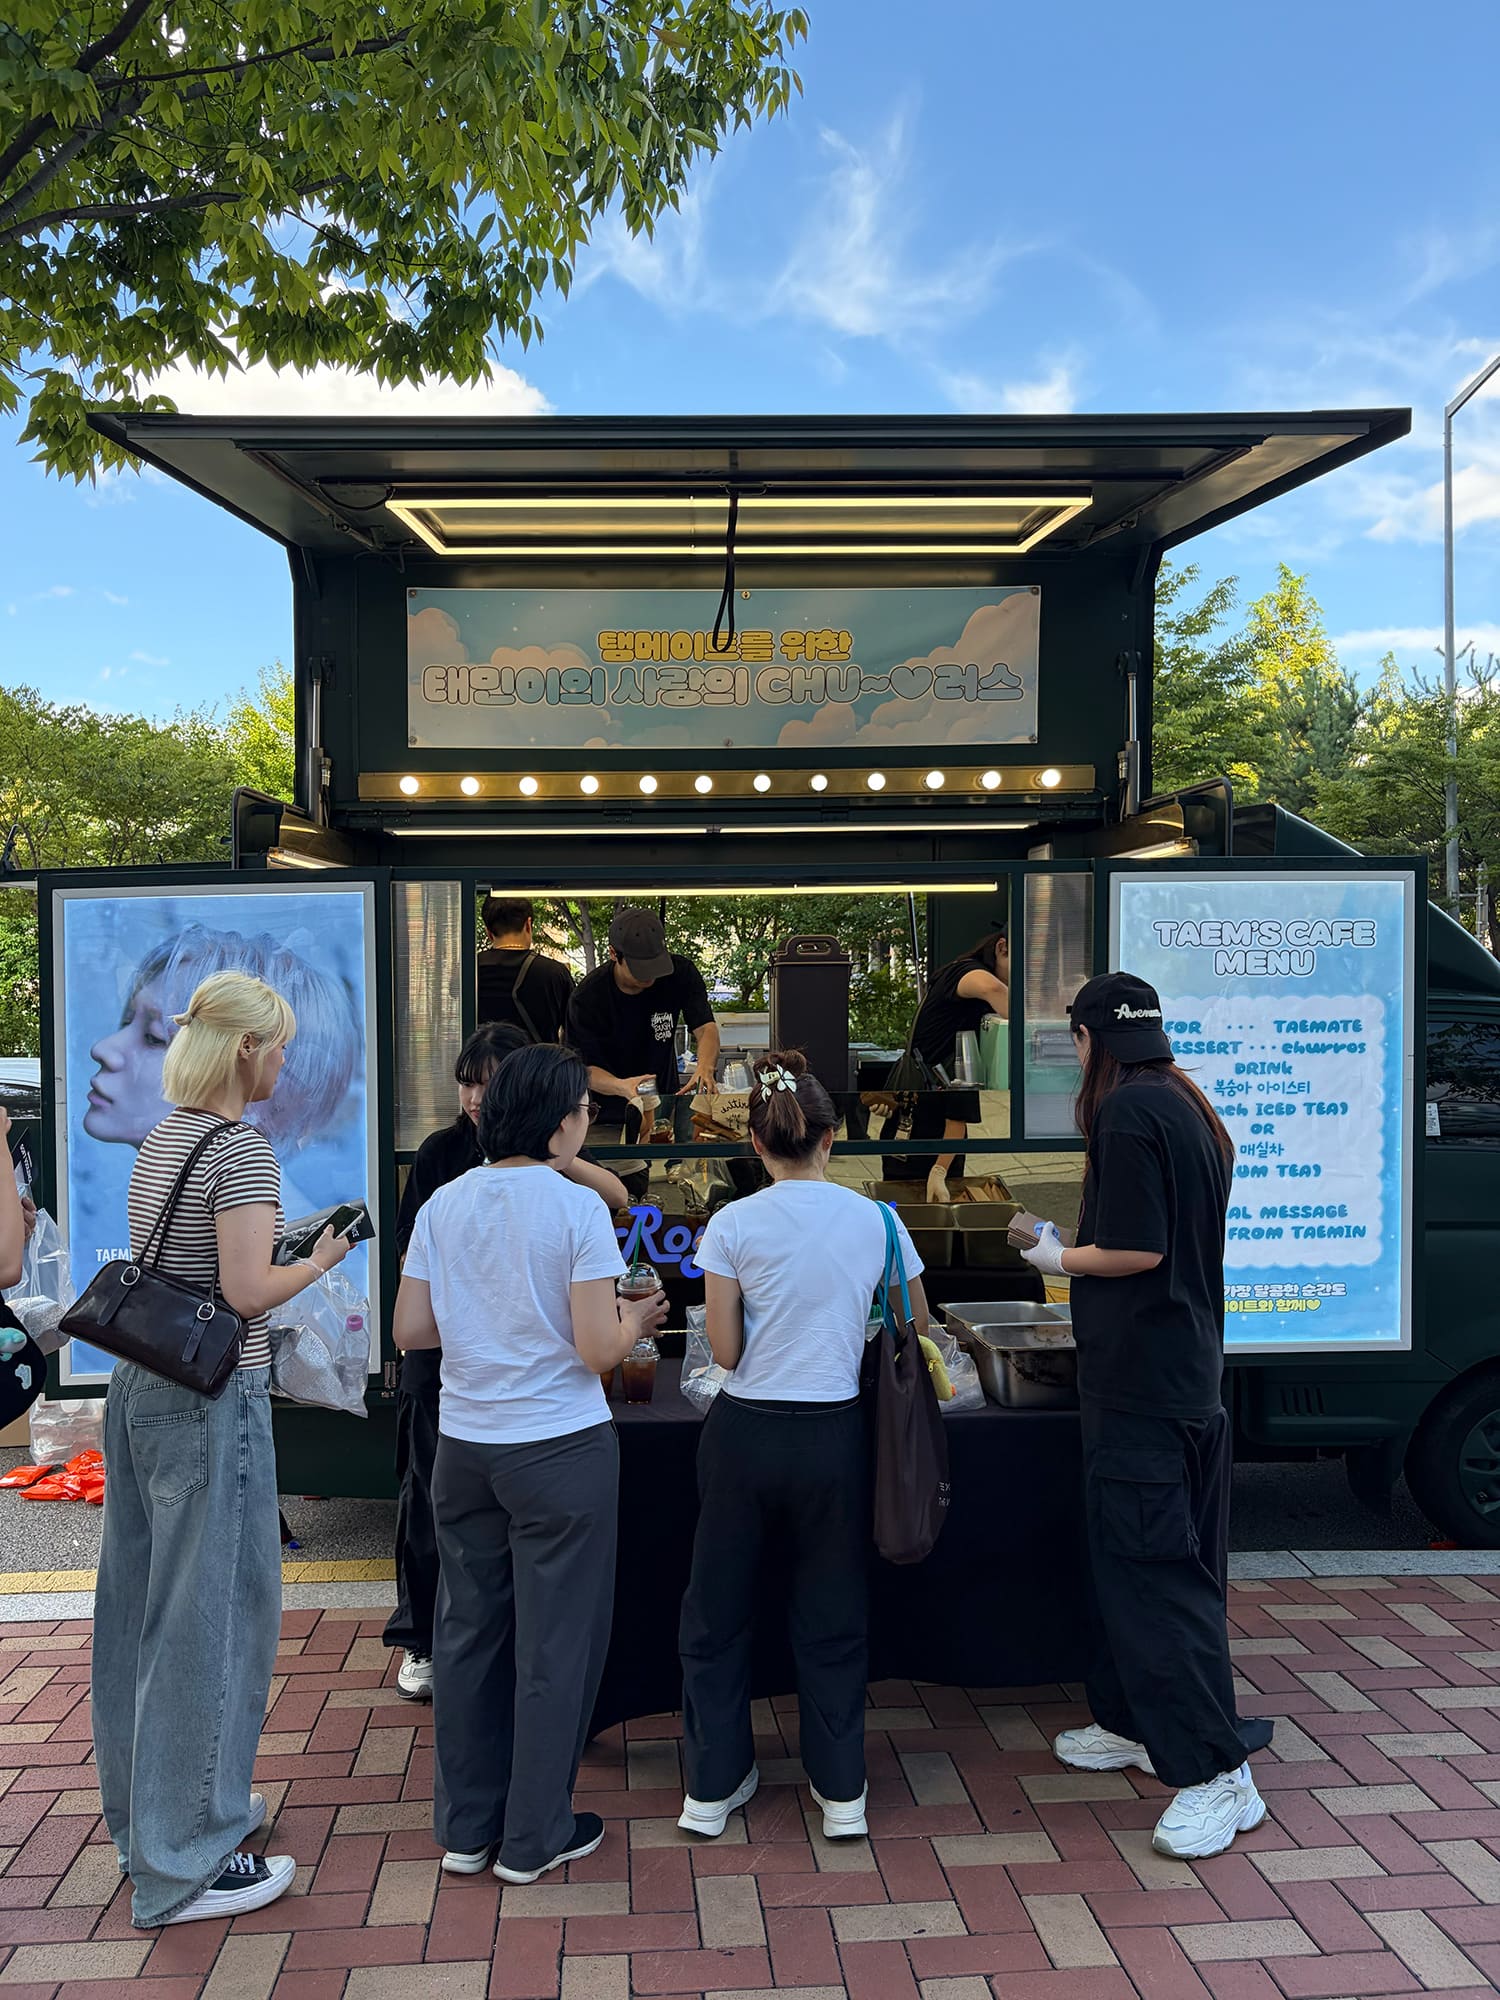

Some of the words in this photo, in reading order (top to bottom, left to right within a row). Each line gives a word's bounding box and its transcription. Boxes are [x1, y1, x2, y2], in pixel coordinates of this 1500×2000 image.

[598, 631, 775, 662] 탬메이트를
[780, 629, 852, 661] 위한
[422, 665, 606, 706] 태민이의
[611, 666, 749, 706] 사랑의
[1285, 920, 1376, 947] CAFE
[1214, 949, 1315, 976] MENU
[1164, 1021, 1202, 1034] FOR
[1273, 1019, 1363, 1034] TAEMATE
[1171, 1040, 1243, 1055] ESSERT
[1214, 1079, 1252, 1097] 복숭아
[1257, 1080, 1311, 1095] 아이스티
[1256, 1102, 1297, 1117] ICED
[1250, 1123, 1275, 1135] OR
[1240, 1141, 1285, 1159] 매실차
[1232, 1164, 1268, 1178] UM
[1260, 1204, 1349, 1219] MESSAGE
[1228, 1226, 1284, 1240] FROM
[1291, 1225, 1367, 1239] TAEMIN
[1253, 1283, 1300, 1298] 달콤한
[1302, 1283, 1346, 1297] 순간도
[1223, 1300, 1274, 1313] 이트와
[1276, 1299, 1306, 1312] 함께
